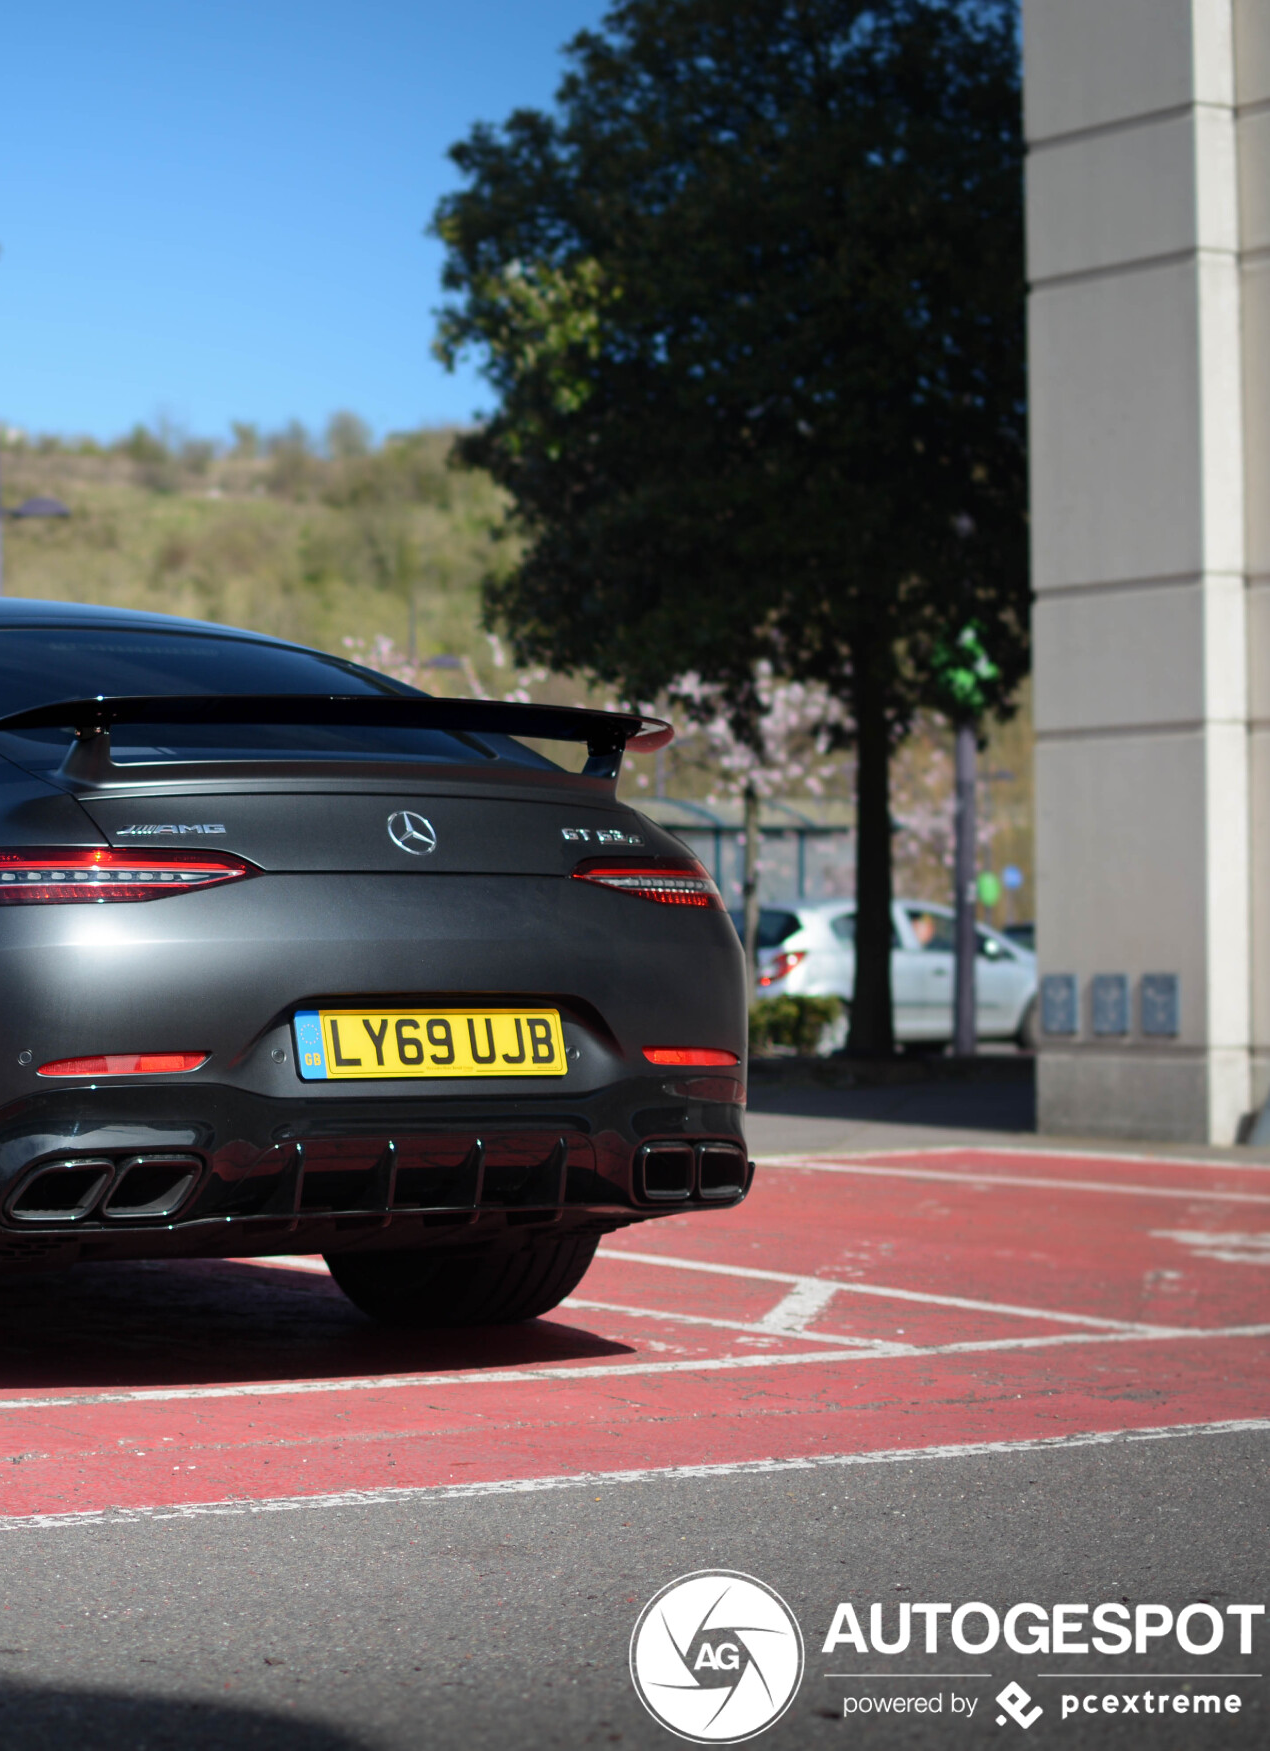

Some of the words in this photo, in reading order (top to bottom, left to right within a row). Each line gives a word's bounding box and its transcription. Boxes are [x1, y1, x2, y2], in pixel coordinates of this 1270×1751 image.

[152, 824, 227, 834] AMG
[561, 828, 590, 841] GT
[330, 1019, 455, 1067] LY69
[467, 1018, 555, 1064] UJB
[304, 1052, 322, 1066] GB
